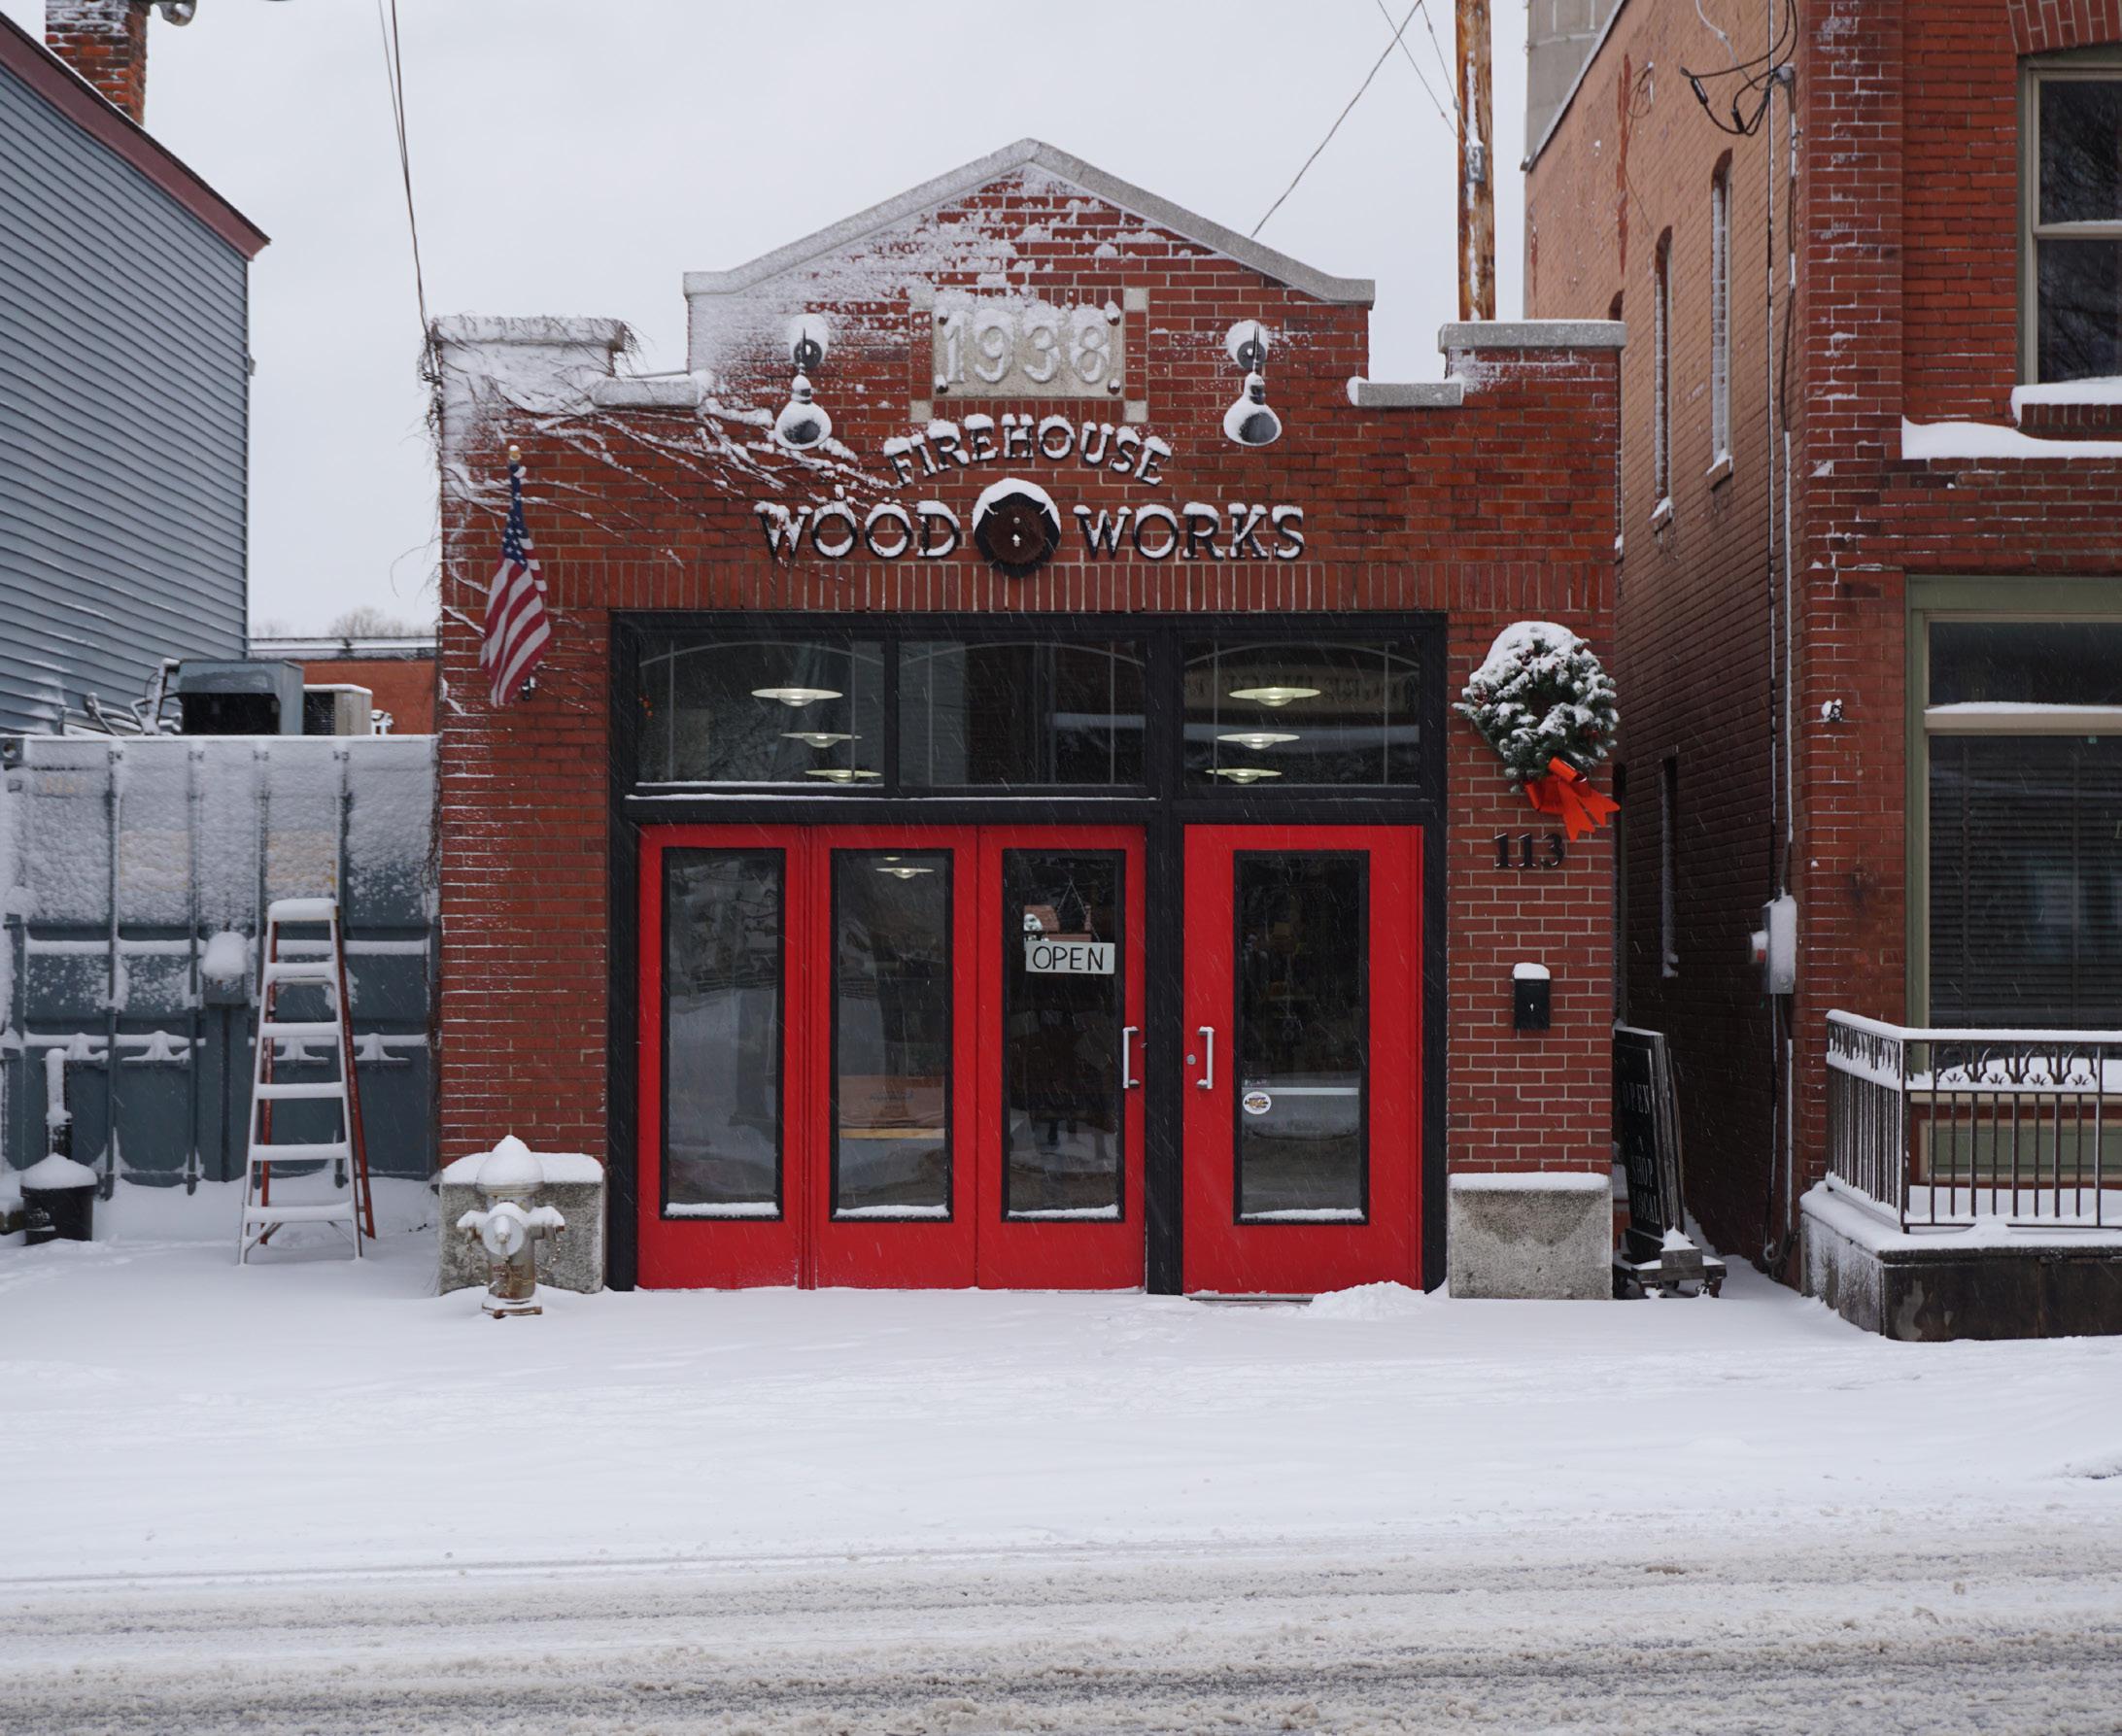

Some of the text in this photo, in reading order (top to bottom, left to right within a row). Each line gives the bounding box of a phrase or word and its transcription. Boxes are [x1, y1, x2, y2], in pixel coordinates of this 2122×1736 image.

[941, 310, 1111, 384] 1938
[883, 414, 1172, 486] FIREHOUSE
[754, 500, 1304, 560] WOOD WORKS
[1493, 833, 1564, 868] 113
[1032, 945, 1104, 970] OPEN
[1621, 1080, 1650, 1114] OPEN
[1631, 1154, 1653, 1187] SHOP
[1632, 1189, 1660, 1225] LOCAL
